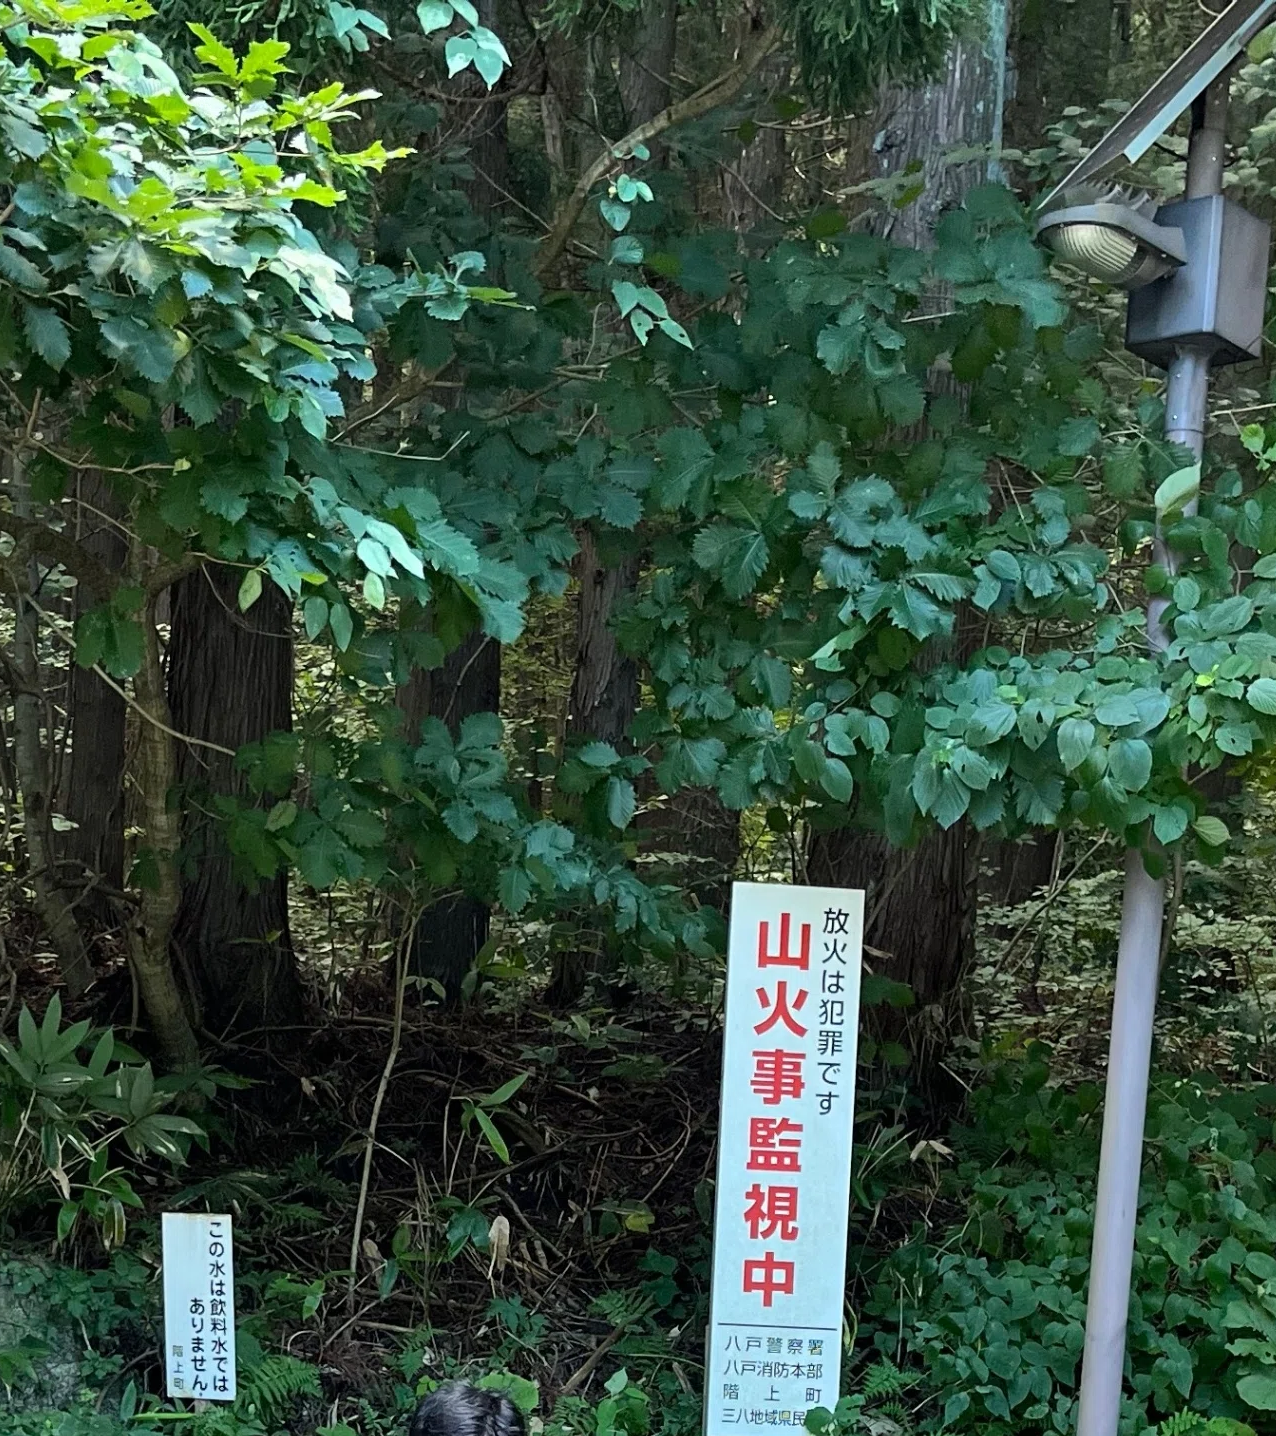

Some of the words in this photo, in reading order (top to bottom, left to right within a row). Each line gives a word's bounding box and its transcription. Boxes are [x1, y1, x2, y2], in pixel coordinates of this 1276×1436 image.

[815, 907, 849, 1116] 放火は犯罪です
[742, 912, 812, 1308] 山火事監視中
[209, 1222, 229, 1393] この水は飲料水では
[724, 1335, 824, 1356] 八戸警察署
[723, 1359, 823, 1379] 八戸消防本部
[723, 1383, 822, 1404] 階上町
[721, 1408, 806, 1427] 三八地域県民
